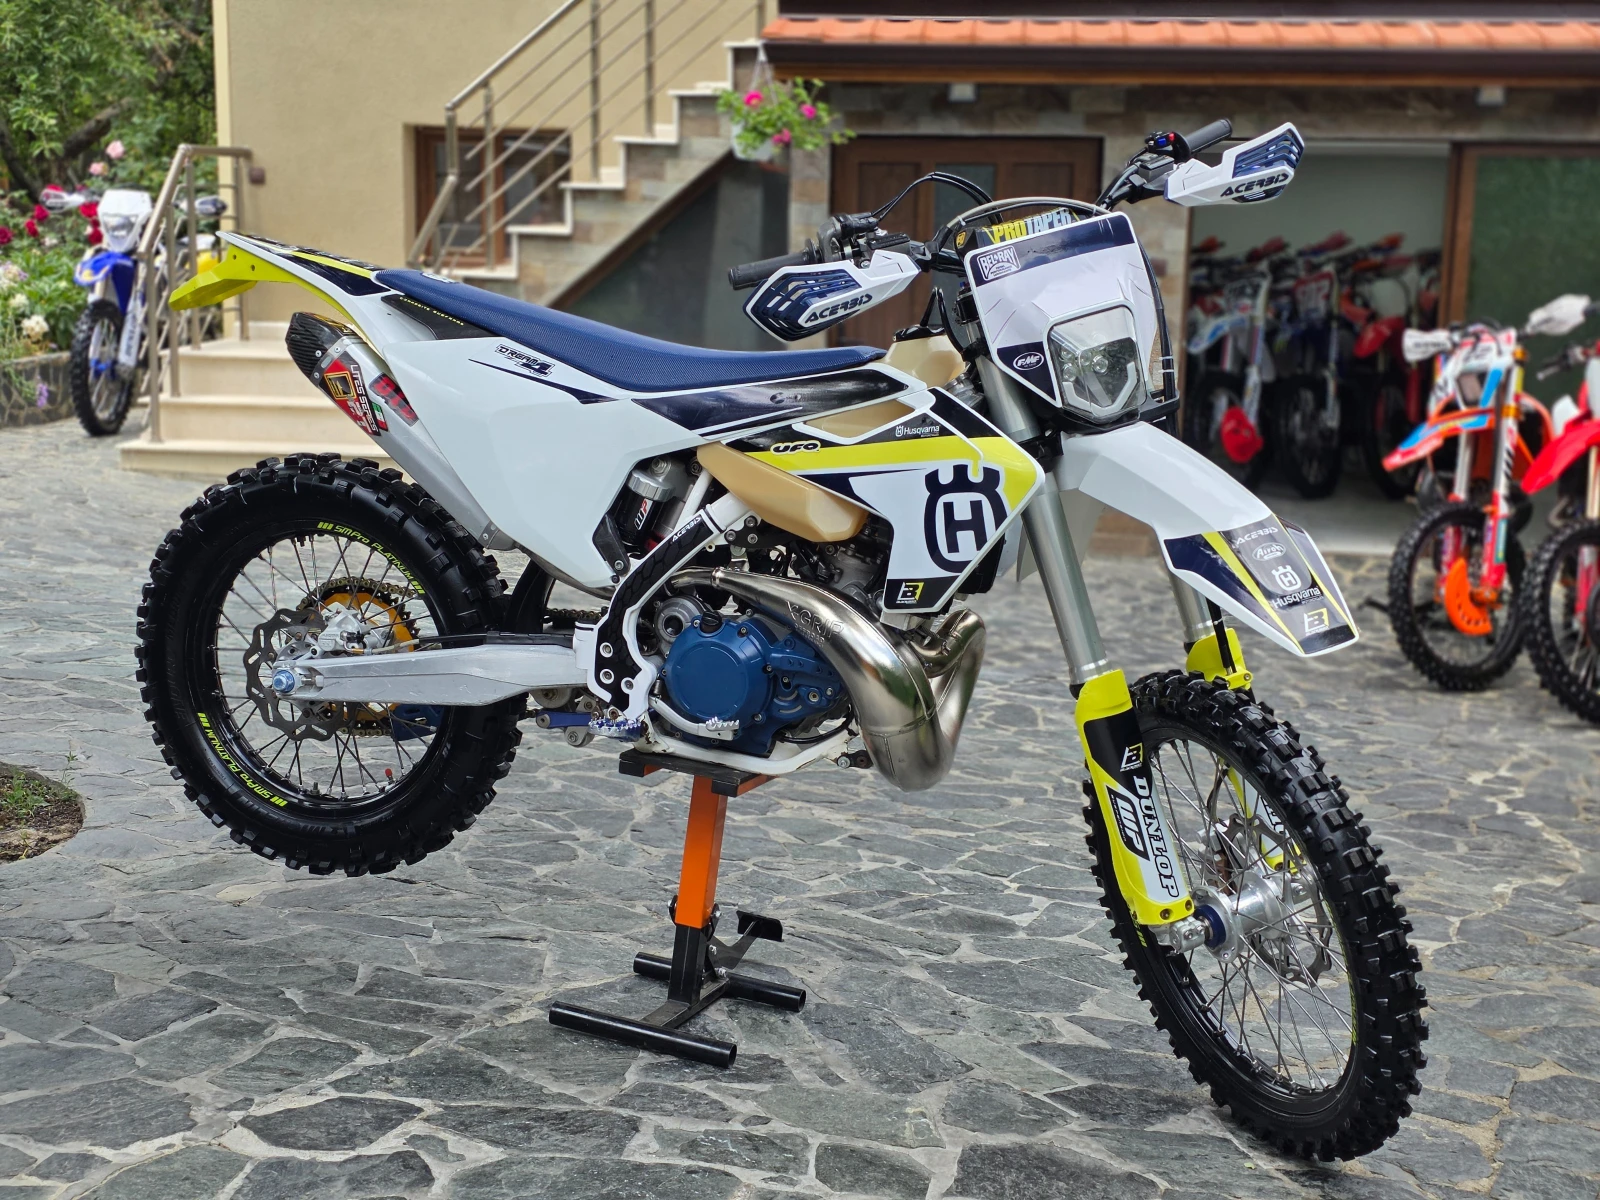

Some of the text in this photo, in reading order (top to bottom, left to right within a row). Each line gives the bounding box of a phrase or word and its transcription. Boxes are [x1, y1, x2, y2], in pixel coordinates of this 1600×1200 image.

[1220, 173, 1289, 198] ACERBIS
[805, 293, 873, 324] ACERBIS
[499, 346, 539, 366] DREAM
[904, 425, 940, 436] Husqvarna
[773, 441, 820, 453] UFO
[1236, 526, 1279, 545] ACERBIS
[371, 542, 414, 580] PLATINUM
[1256, 544, 1285, 559] Airoh
[1271, 587, 1320, 609] Husqvarna
[205, 729, 241, 772] PLATINUM
[1132, 775, 1180, 898] DUNLOP
